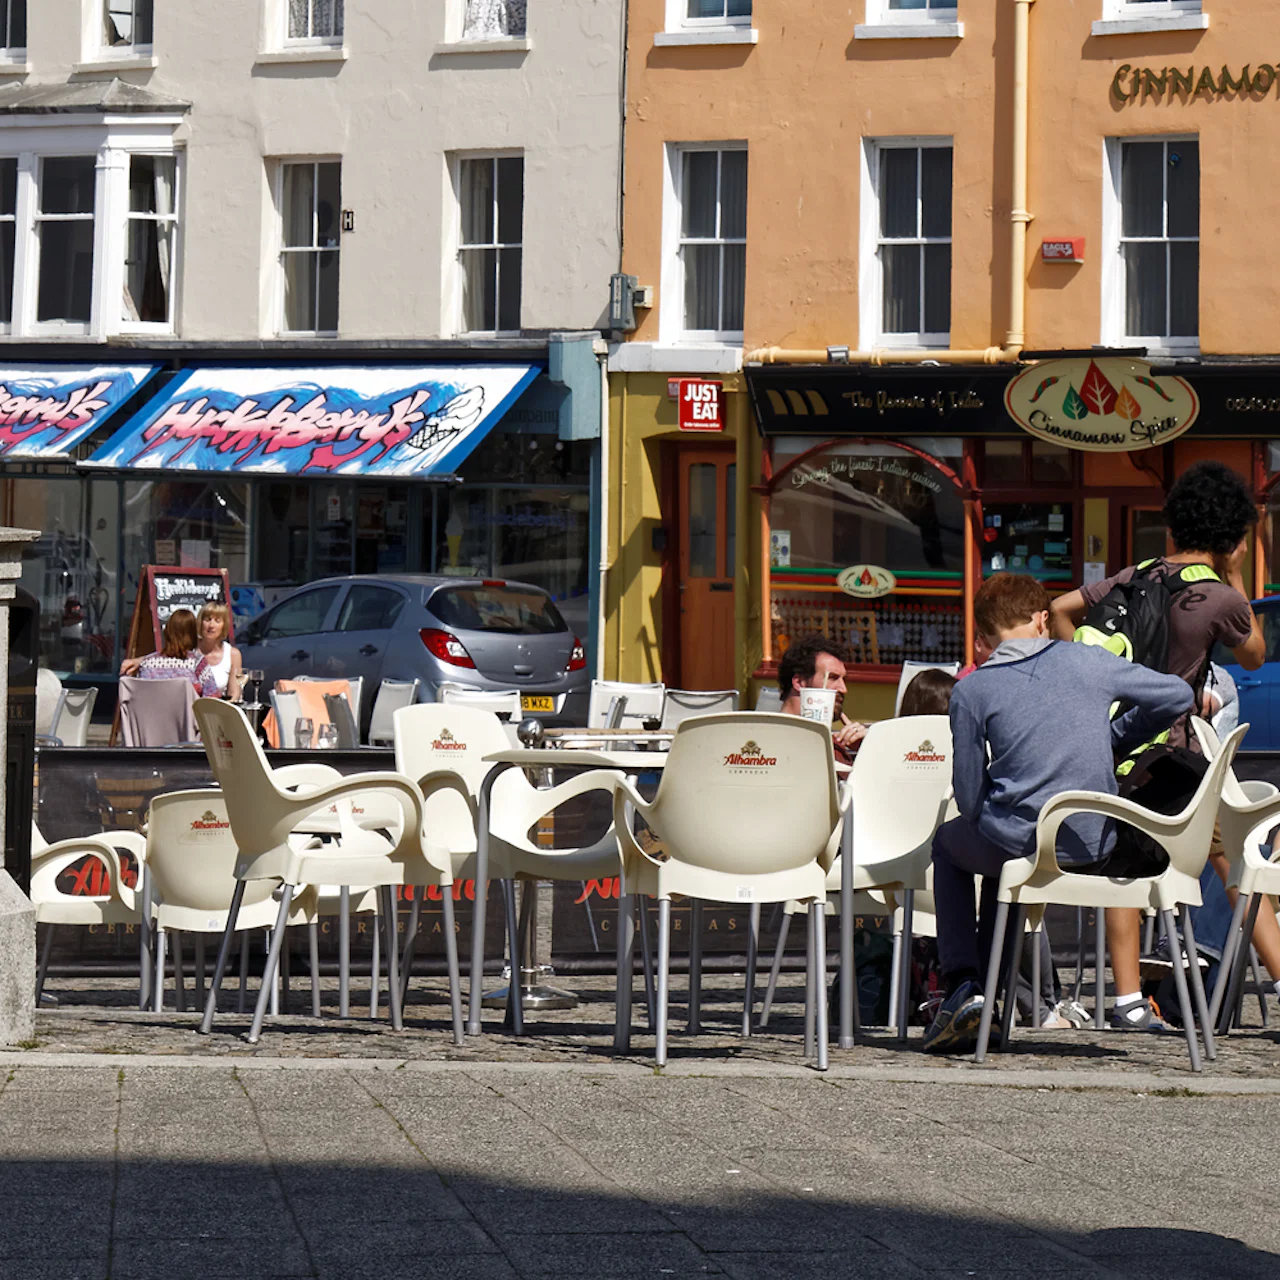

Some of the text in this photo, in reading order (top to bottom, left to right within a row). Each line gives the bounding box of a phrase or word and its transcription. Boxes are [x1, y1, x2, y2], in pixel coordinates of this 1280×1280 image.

[1042, 243, 1072, 251] EAGLE
[684, 384, 718, 402] JUST
[841, 390, 873, 408] The
[948, 390, 985, 408] India
[693, 402, 719, 420] EAT
[1028, 409, 1178, 445] Cinnamon Spice
[430, 739, 467, 751] Alhambra
[724, 752, 777, 766] Alhambra
[903, 751, 946, 763] Alhambra
[190, 820, 230, 830] Alhambra
